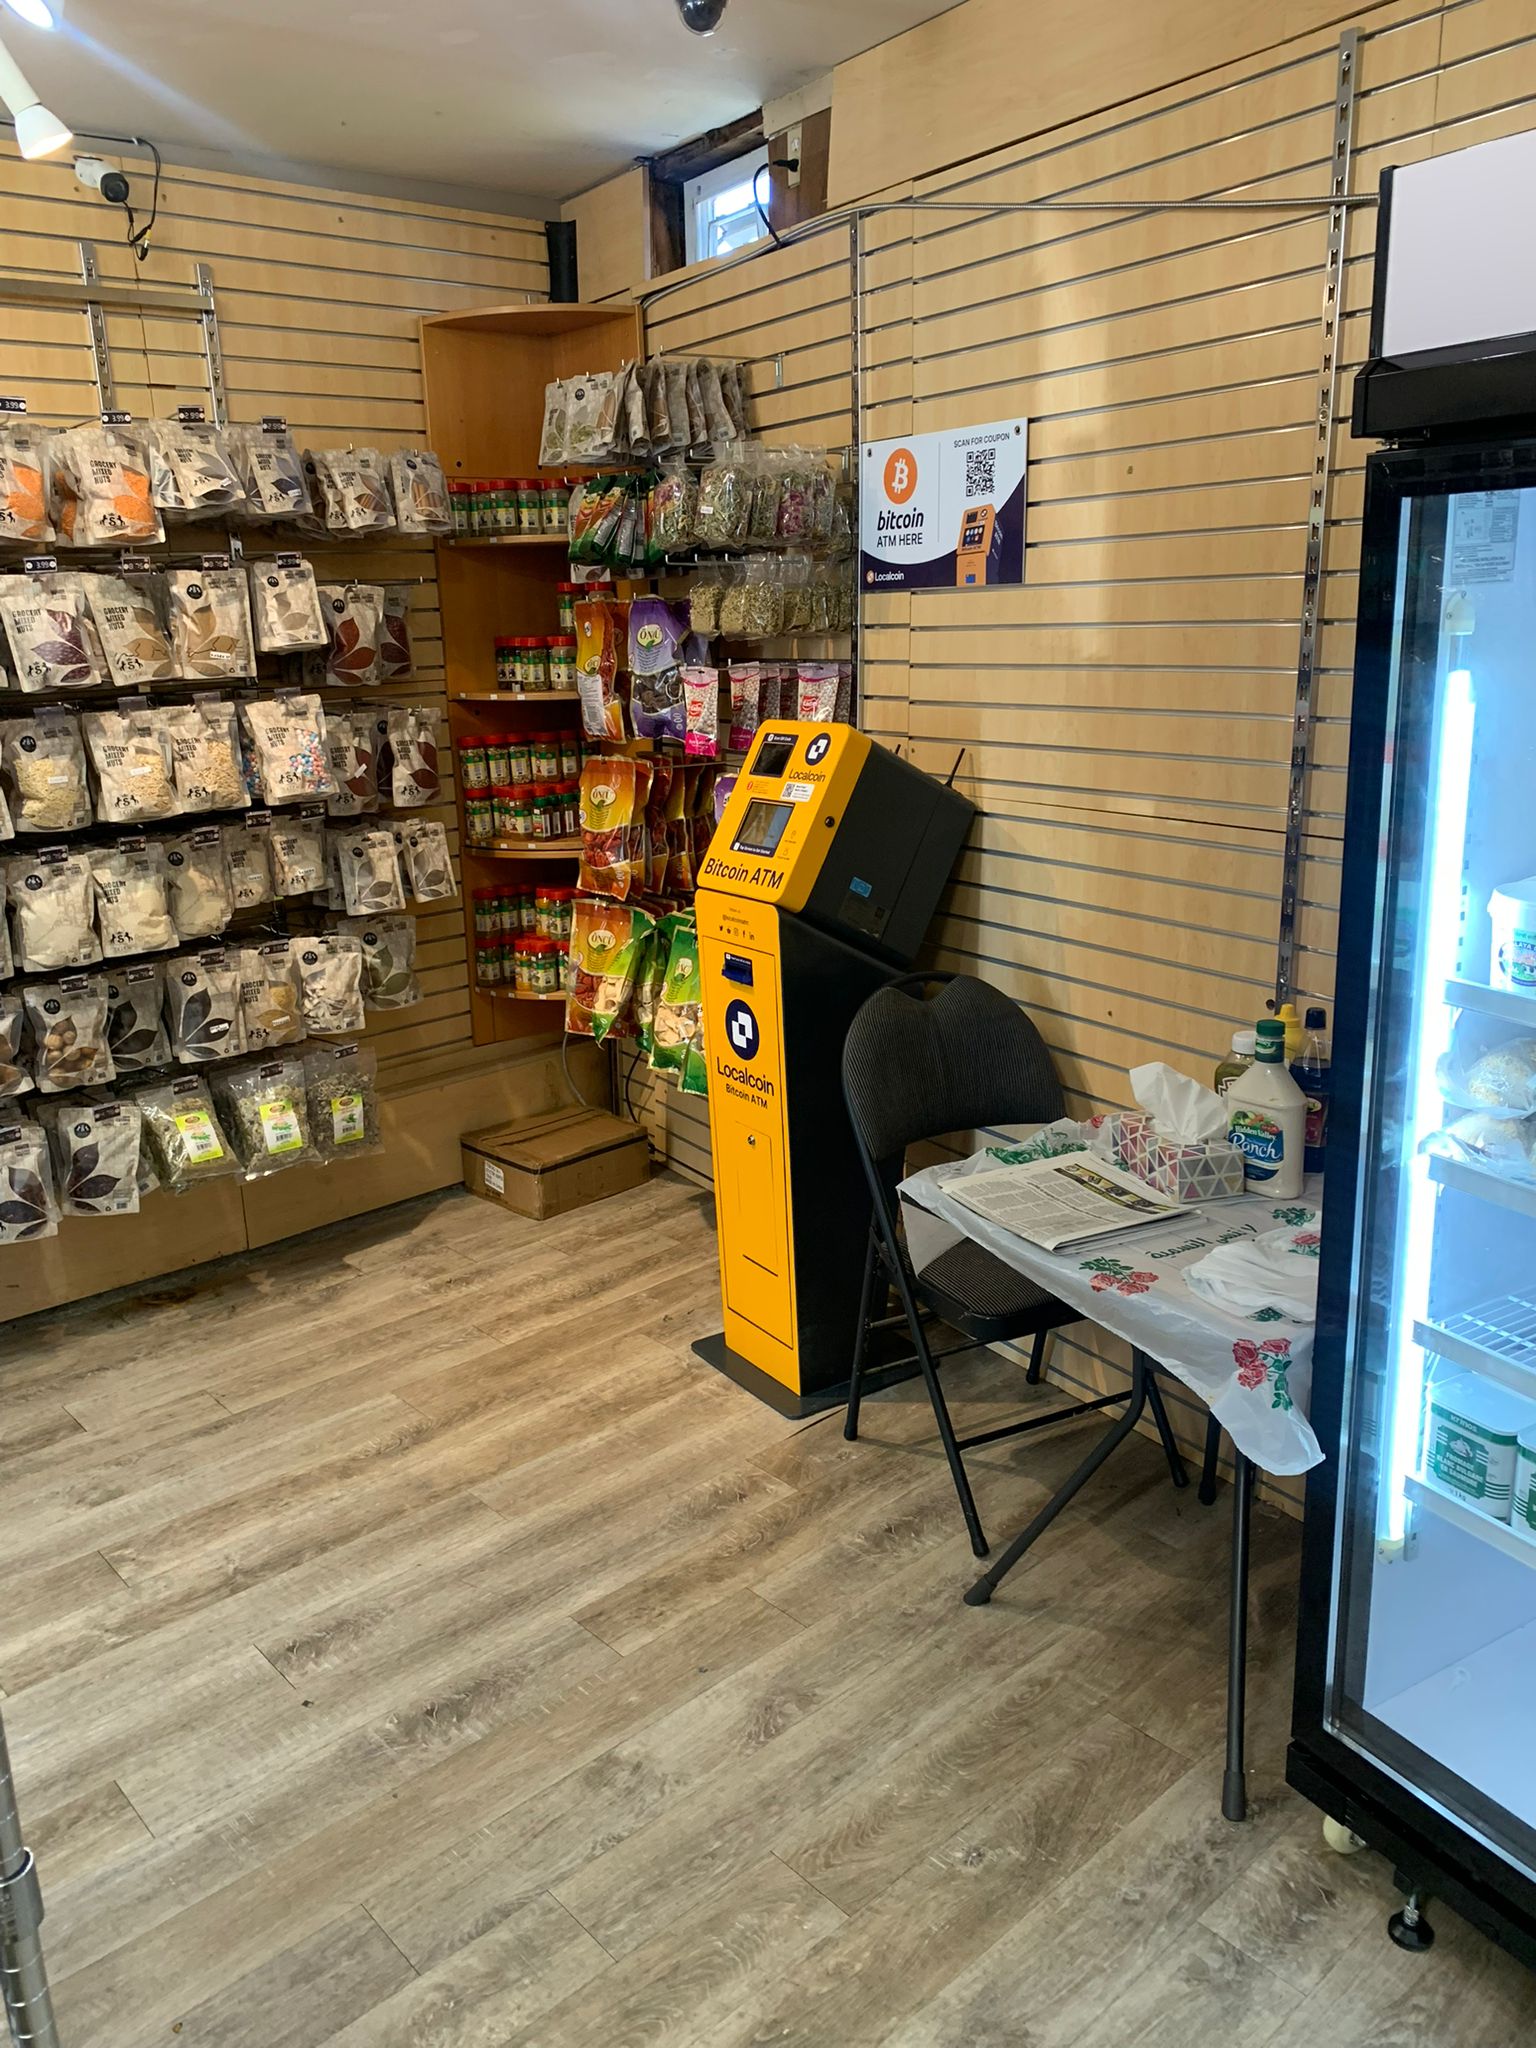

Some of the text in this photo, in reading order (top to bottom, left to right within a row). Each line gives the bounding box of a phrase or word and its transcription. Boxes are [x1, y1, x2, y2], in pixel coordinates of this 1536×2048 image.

[953, 433, 1010, 448] SCAN FOR COUPON
[877, 507, 924, 531] bitcoin
[877, 533, 923, 548] ATM HERE
[874, 571, 904, 582] Localcoin
[789, 768, 826, 782] Localcoin
[704, 858, 785, 889] Bitcoin ATM
[717, 1056, 775, 1097] Localcoin
[726, 1083, 768, 1109] Bitcoin ATM
[1230, 1132, 1282, 1159] Ranch
[1145, 1237, 1213, 1259] التسمية
